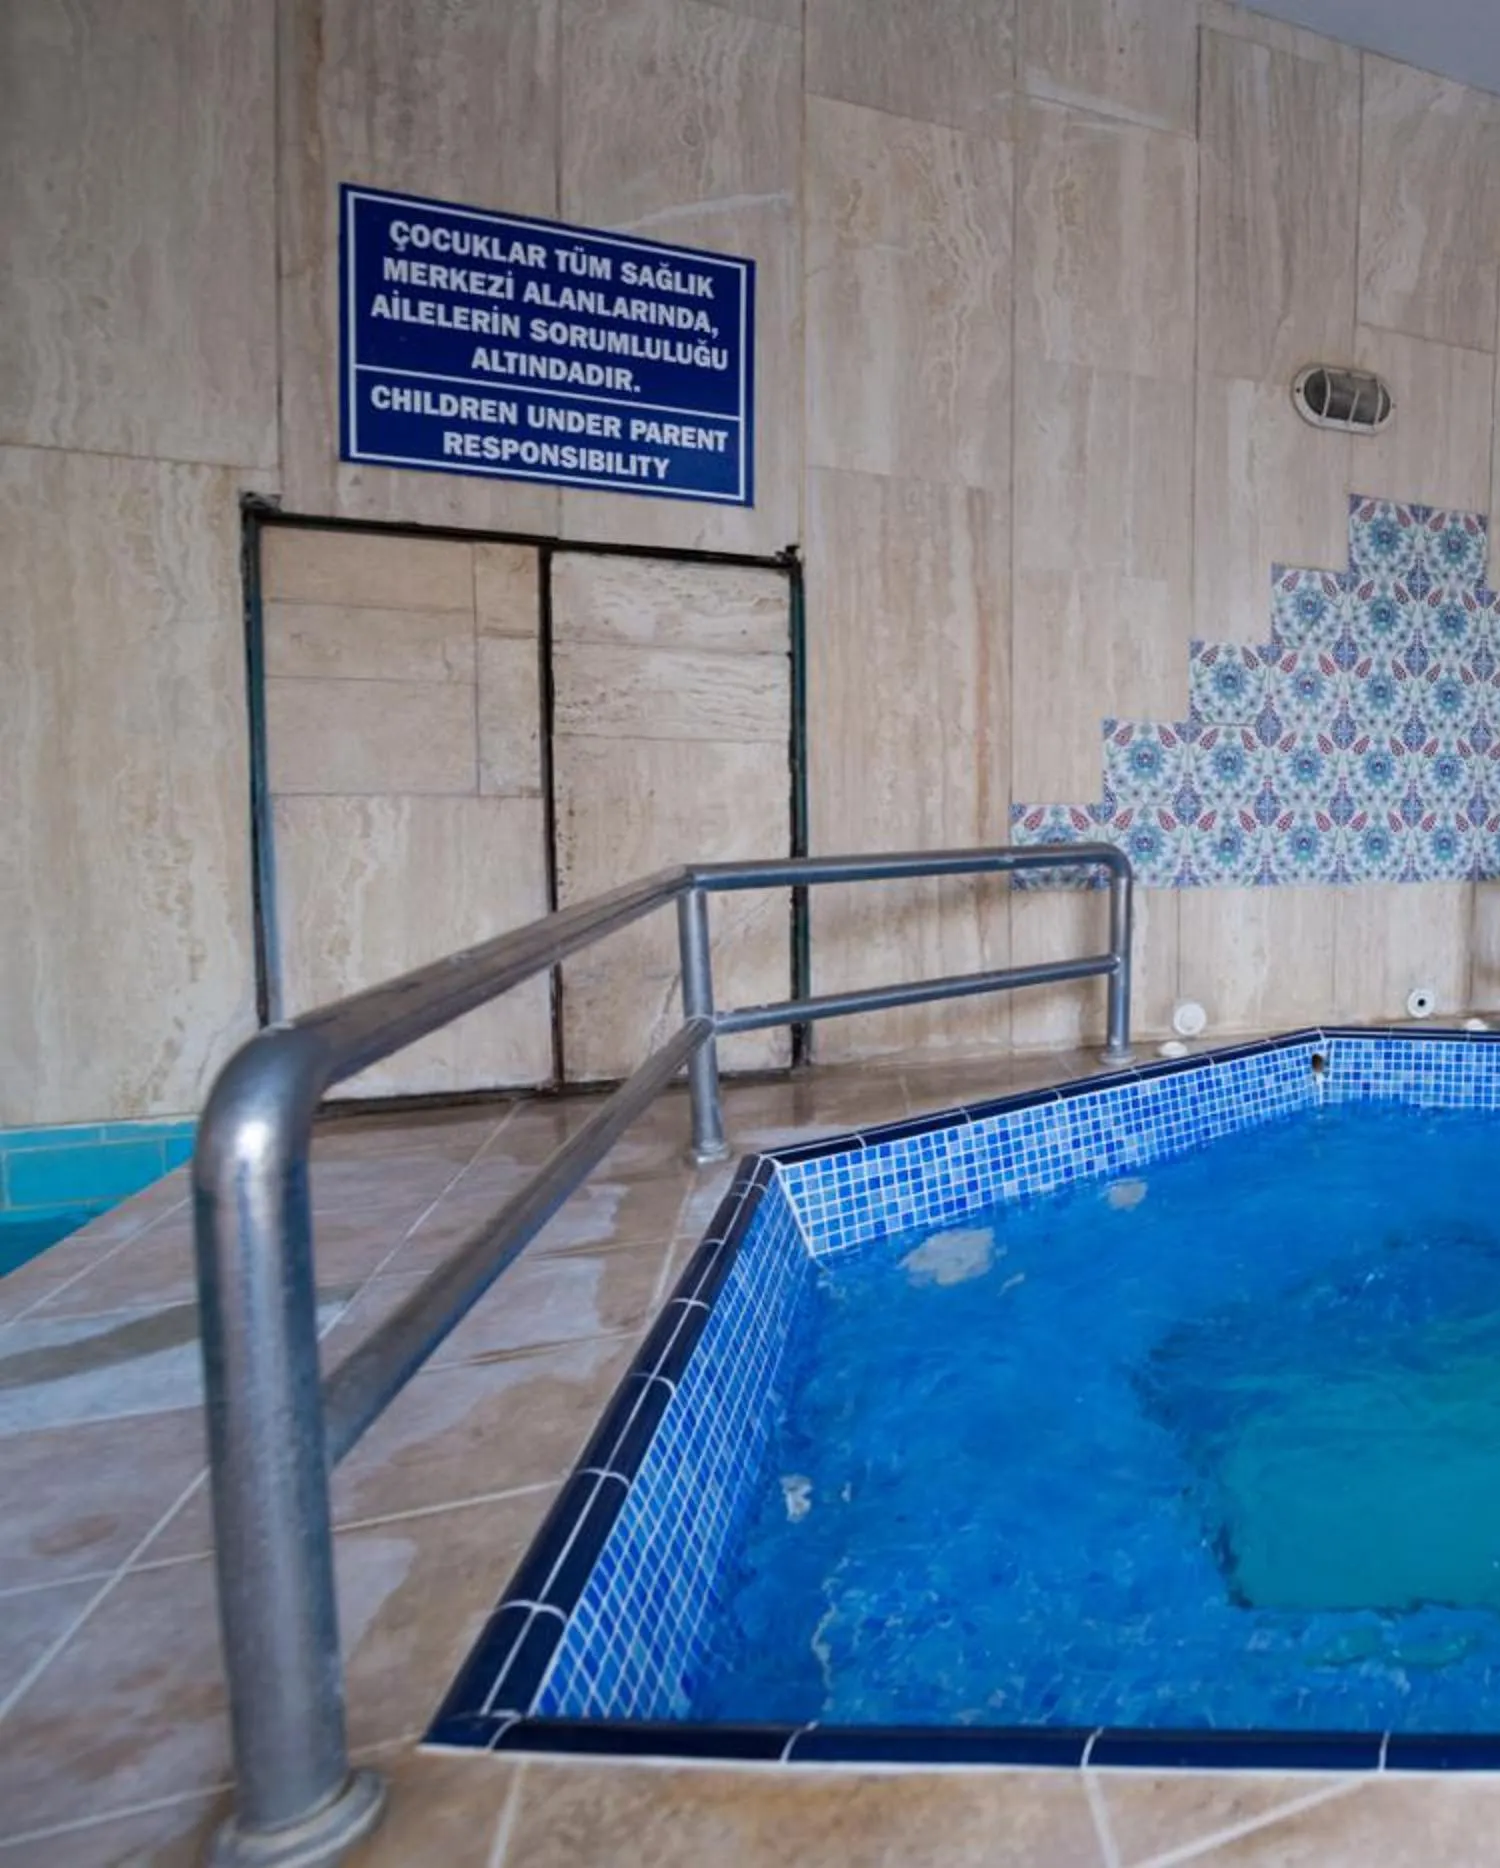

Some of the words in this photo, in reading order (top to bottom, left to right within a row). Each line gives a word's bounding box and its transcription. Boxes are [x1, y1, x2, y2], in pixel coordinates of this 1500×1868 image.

[389, 219, 547, 269] ÇOCUKLAR
[554, 245, 612, 281] TÜM
[620, 261, 714, 299] SAĞLIK
[371, 289, 521, 338] AİLELERİN
[529, 318, 728, 371] SORUMLULUĞU
[383, 257, 514, 300] MERKEZİ
[523, 281, 719, 339] ALANLARINDA,
[471, 347, 641, 393] ALTINDADIR.
[370, 385, 518, 425] CHILDREN
[527, 404, 622, 439] UNDER
[629, 418, 729, 453] PARENT
[443, 431, 671, 480] RESPONSIBILITY
